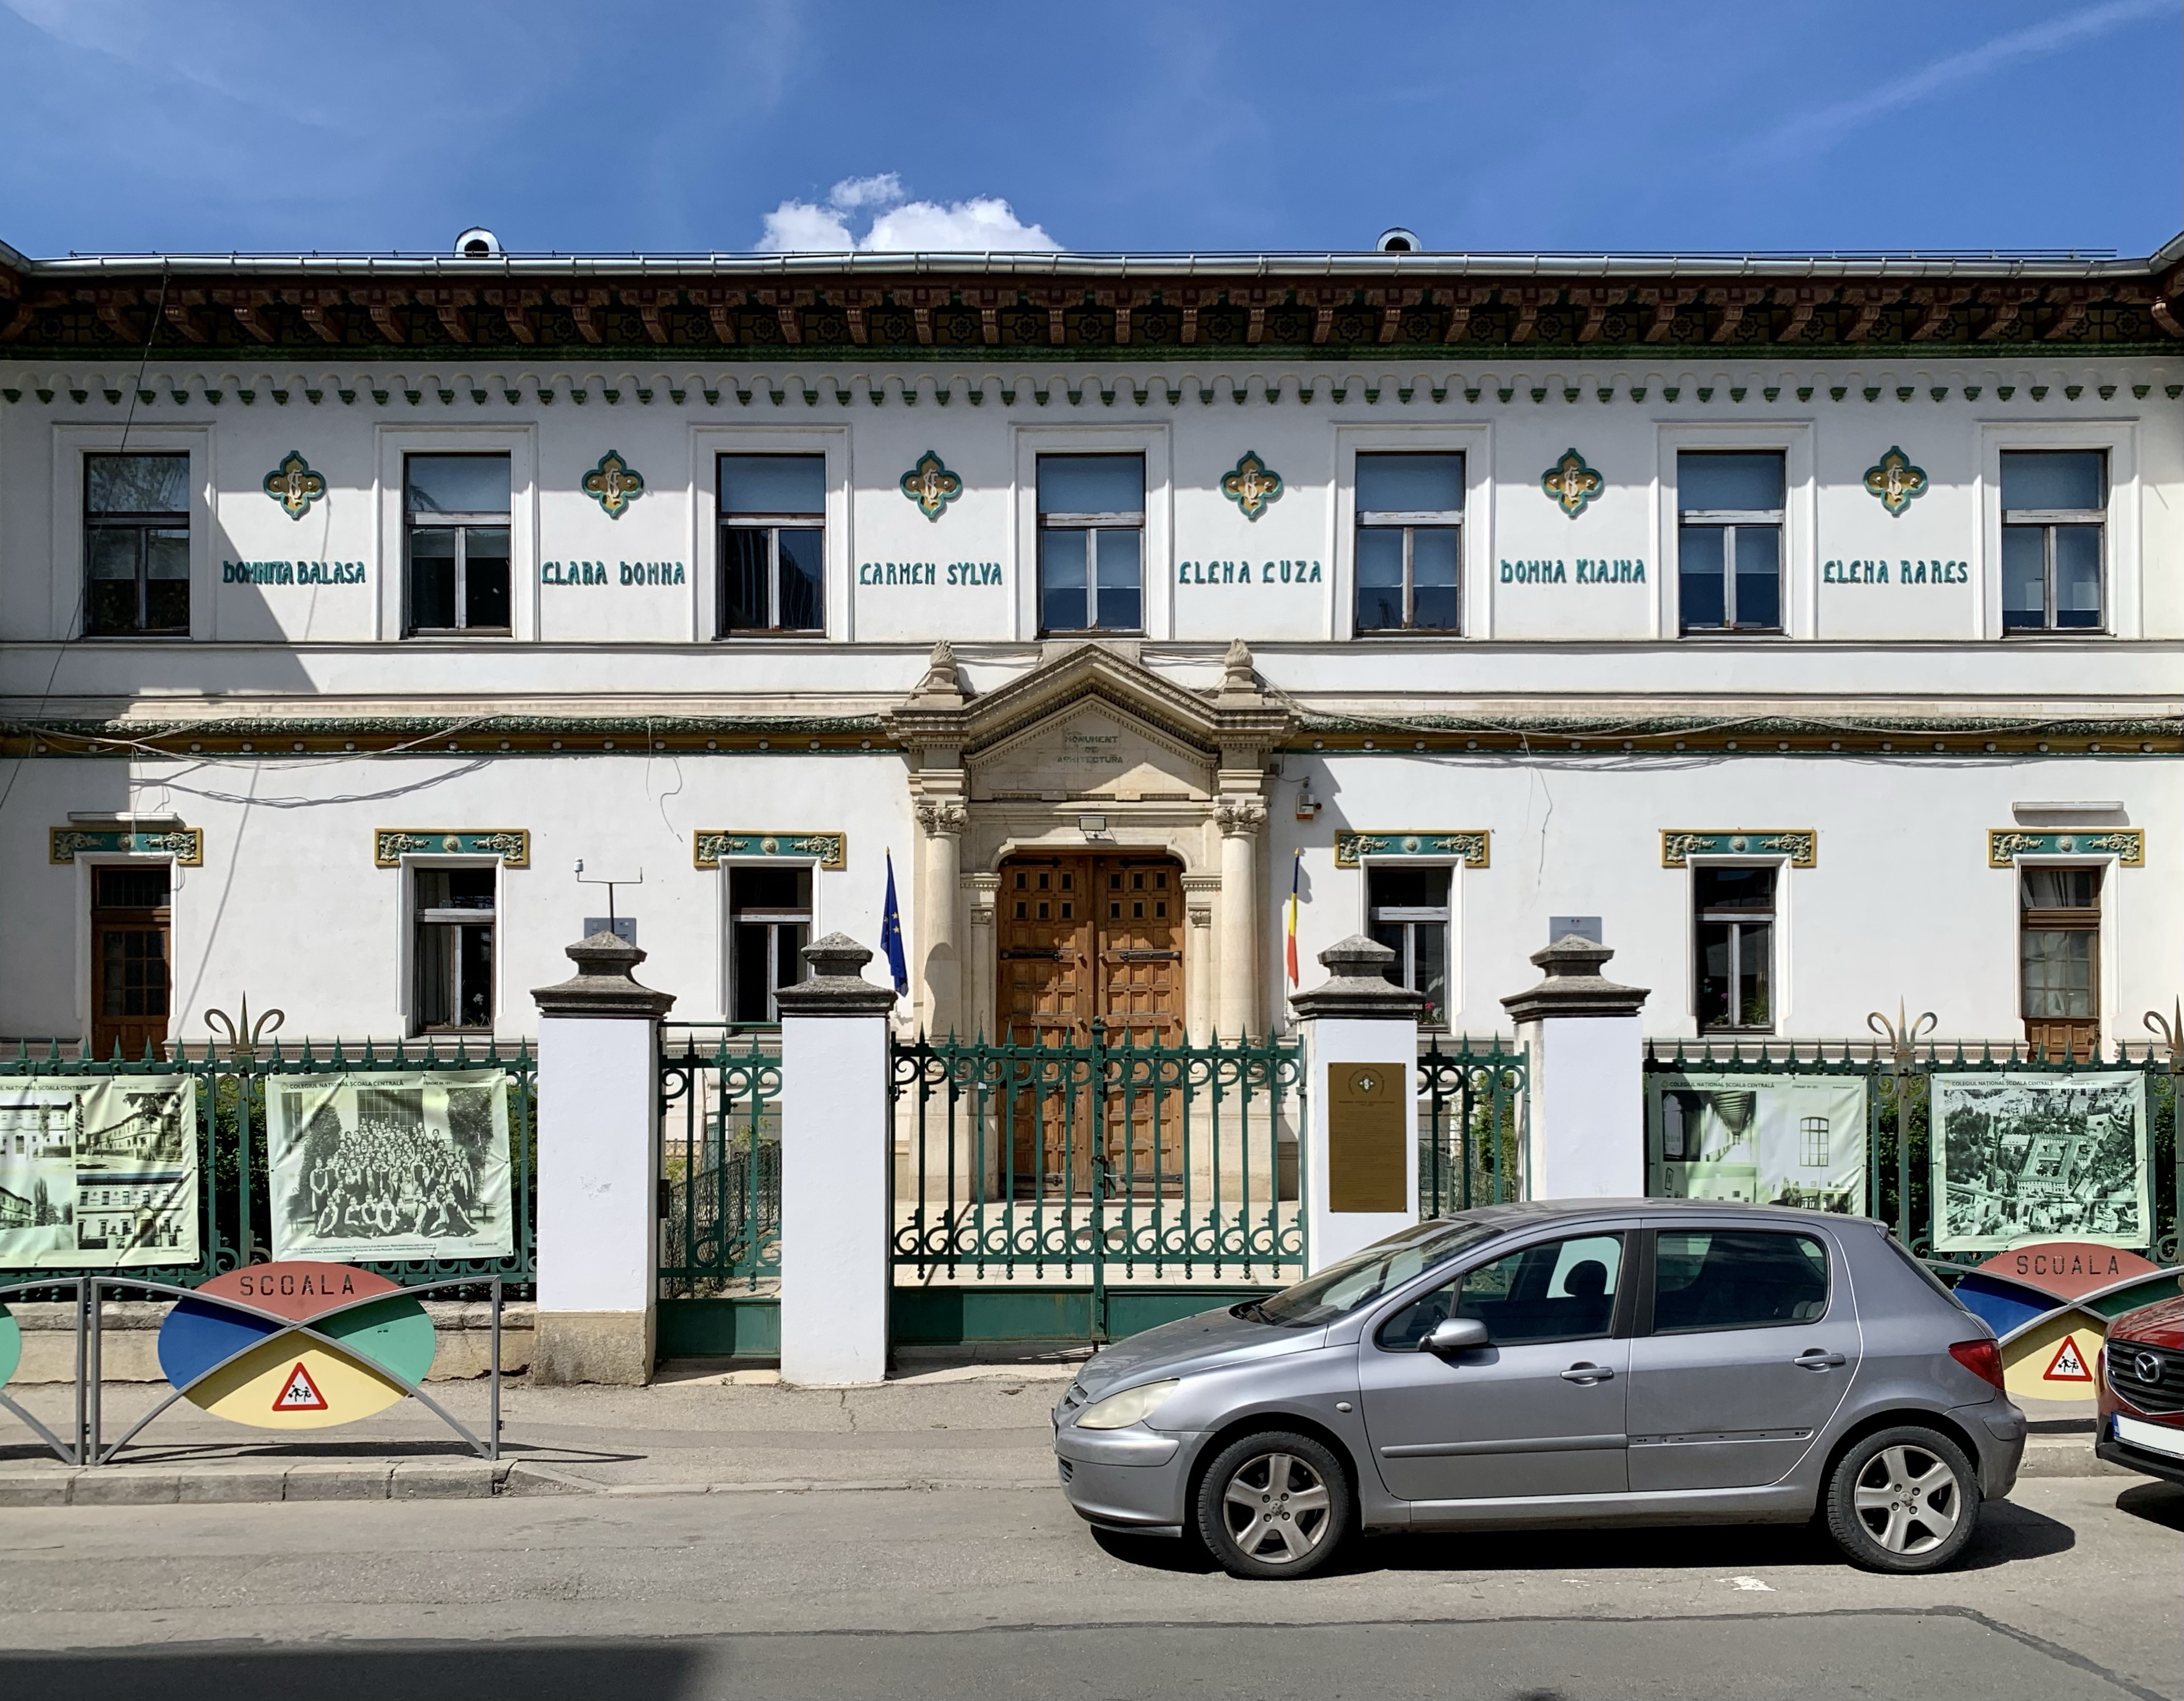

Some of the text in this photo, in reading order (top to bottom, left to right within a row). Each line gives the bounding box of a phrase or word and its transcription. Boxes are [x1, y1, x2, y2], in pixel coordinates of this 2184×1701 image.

[297, 561, 366, 585] BALASA
[542, 561, 685, 585] CLARA DOMNA
[860, 562, 1003, 585] CARMEN SYLVA
[1178, 560, 1322, 584] ELENA CUZA
[1500, 559, 1646, 585] DOMNA KIAJNA
[1823, 560, 1968, 585] ELENA RARES
[2017, 1255, 2120, 1275] SCOALA
[240, 1274, 354, 1296] SCOALA
